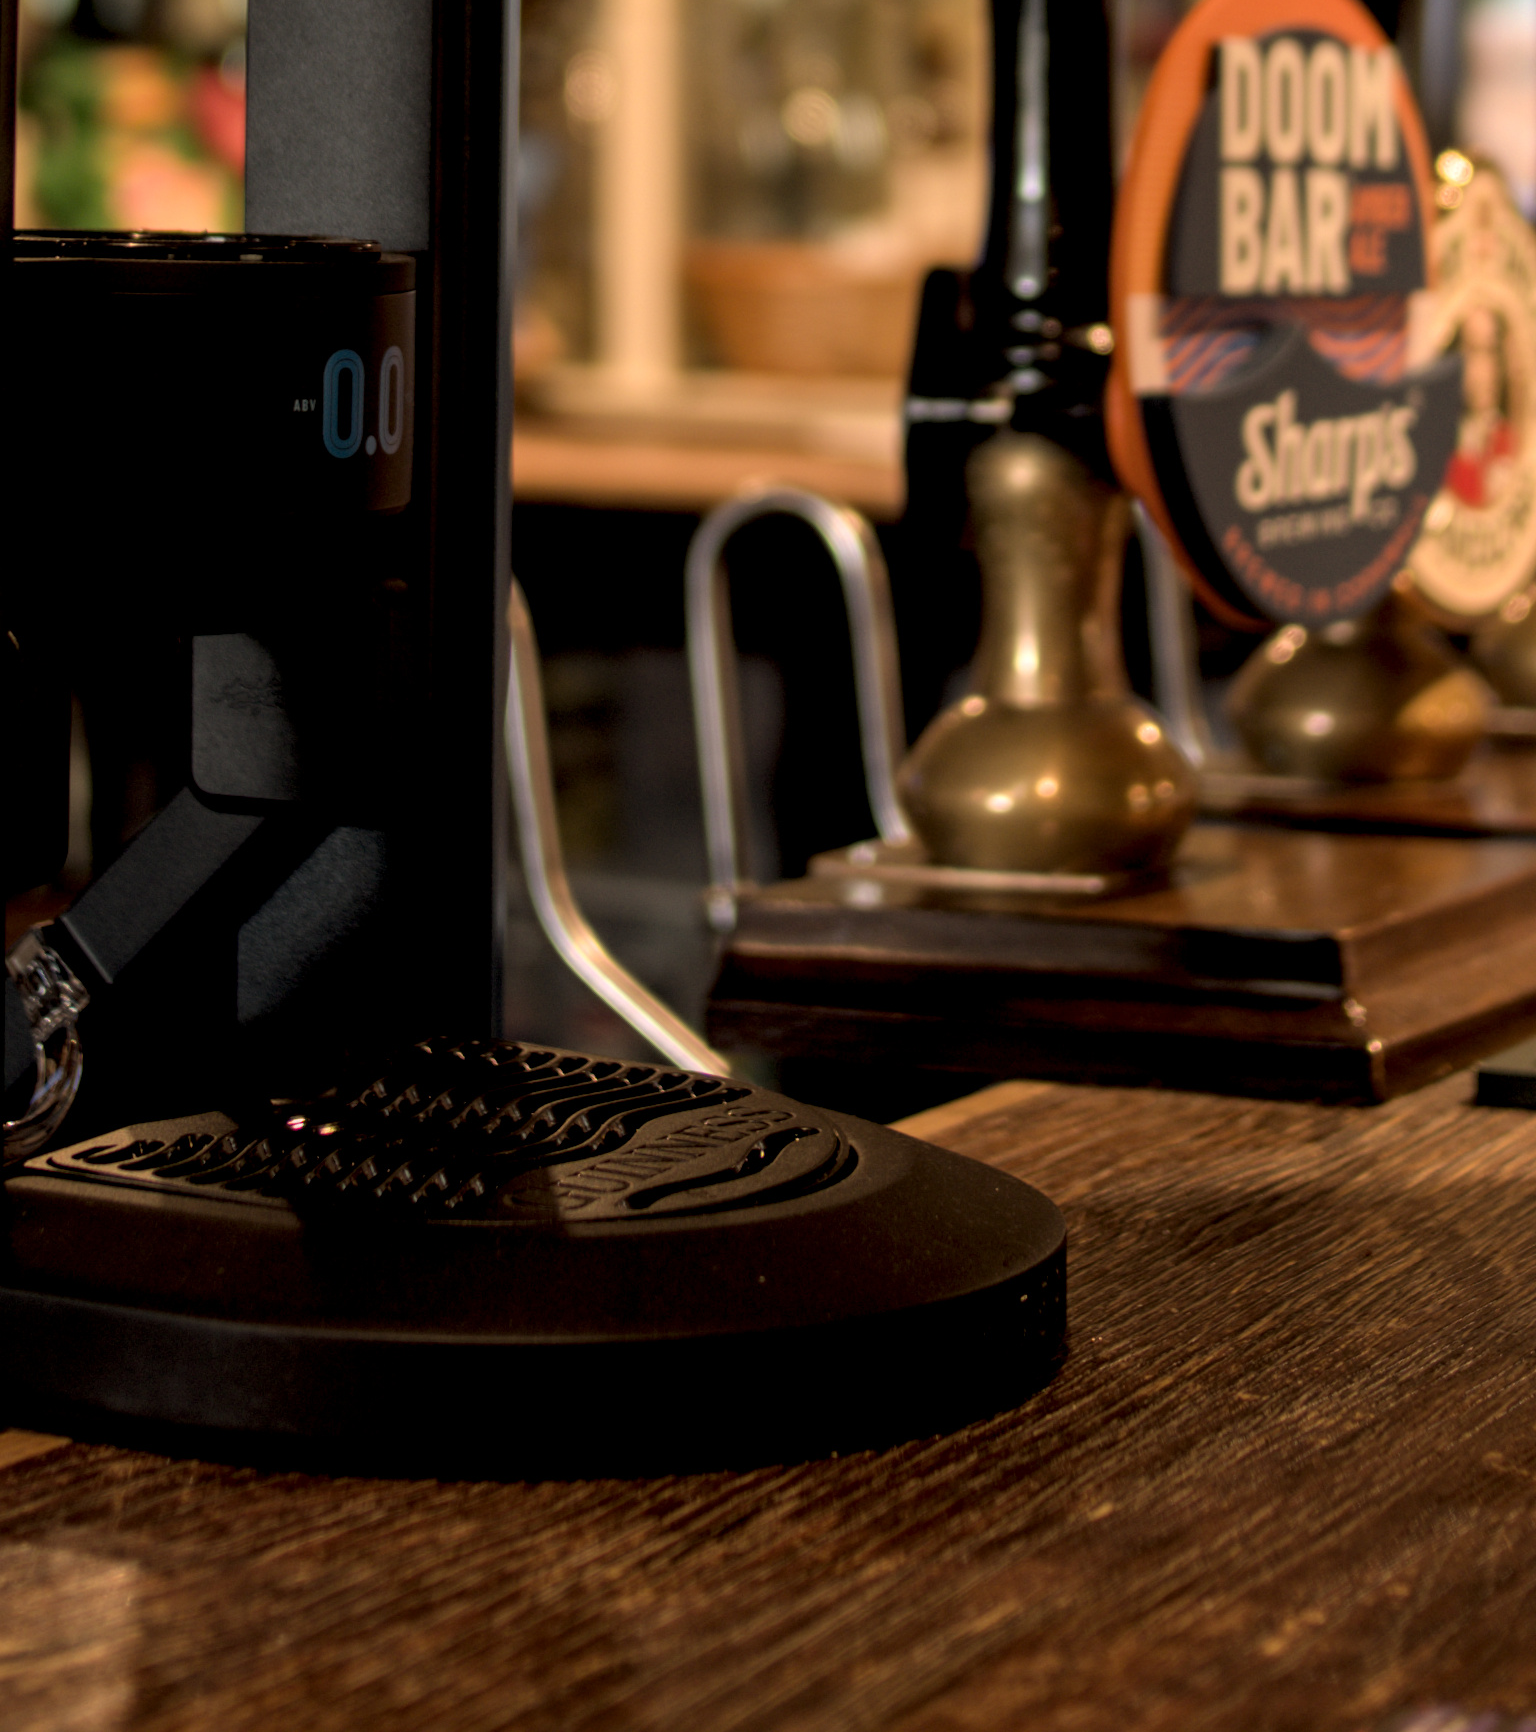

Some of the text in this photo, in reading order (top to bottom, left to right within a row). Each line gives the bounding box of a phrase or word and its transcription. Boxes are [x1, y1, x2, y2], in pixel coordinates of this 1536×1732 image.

[1219, 34, 1399, 171] DOOM
[1219, 165, 1353, 298] BAR
[292, 344, 405, 460] ABV 0.0
